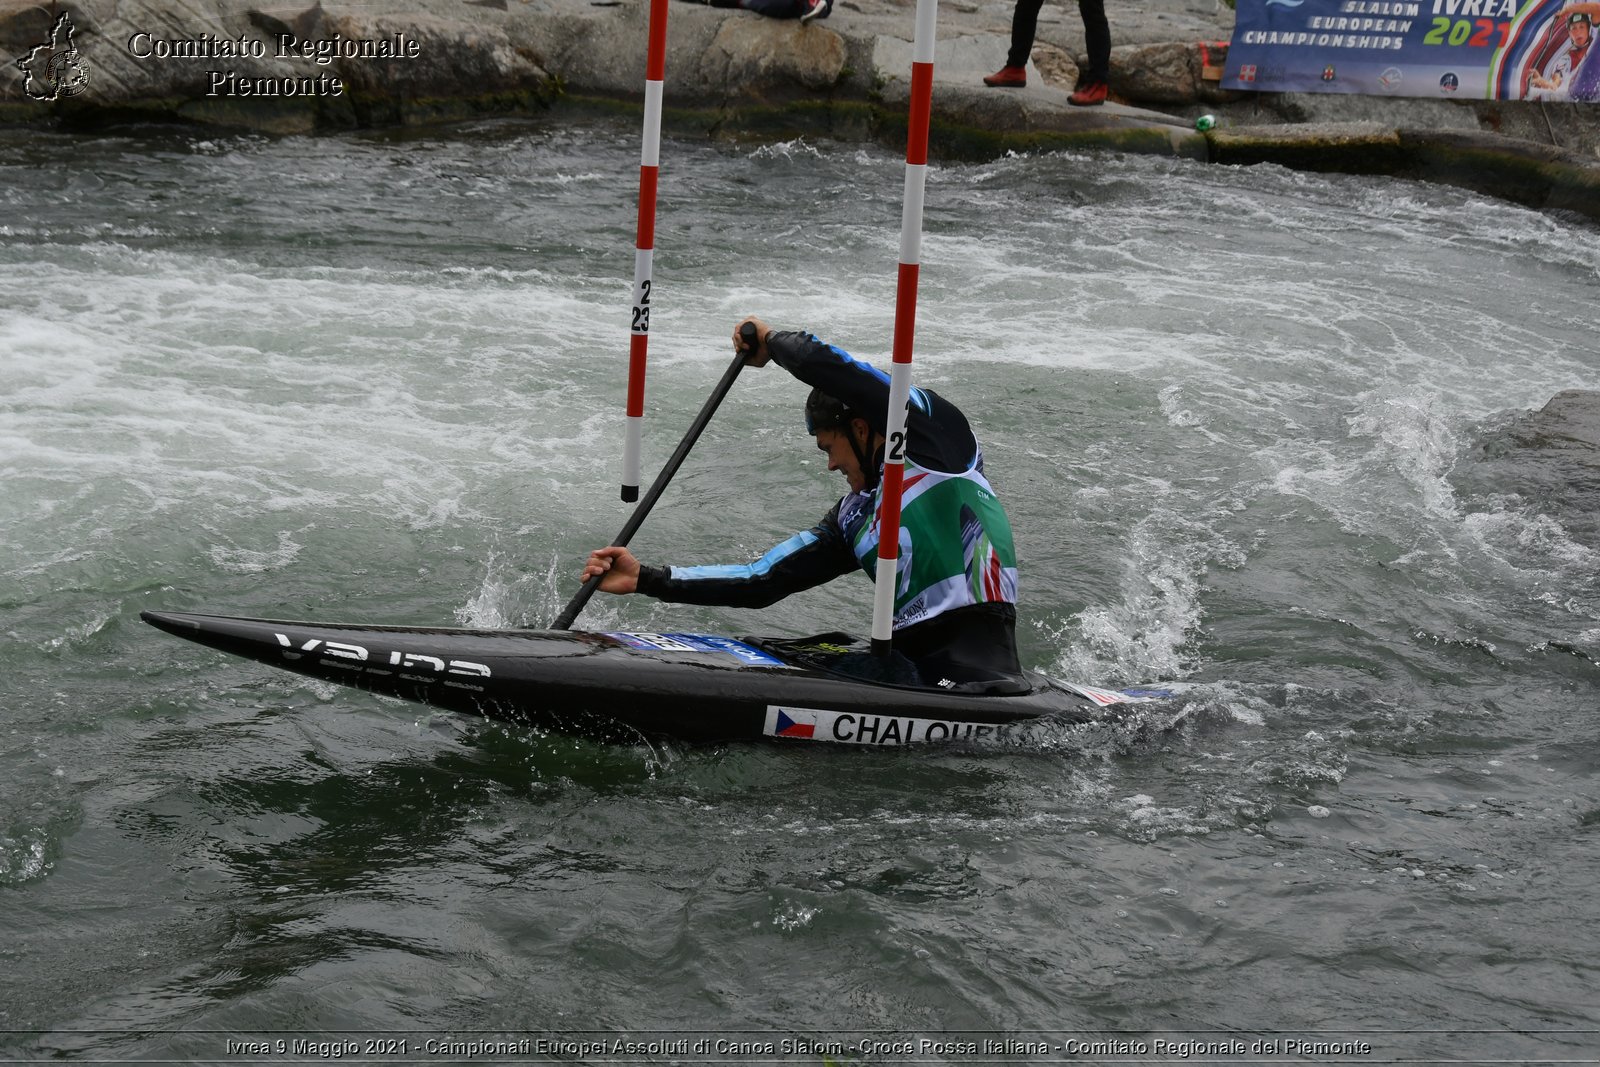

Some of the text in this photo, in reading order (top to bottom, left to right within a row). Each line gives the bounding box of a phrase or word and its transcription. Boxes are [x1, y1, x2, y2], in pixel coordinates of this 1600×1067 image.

[1347, 2, 1419, 17] SLALOM
[1432, 0, 1517, 18] IVREA
[1312, 16, 1412, 33] EUROPEAN
[1423, 17, 1510, 48] 2021
[1245, 31, 1403, 50] CHAMPIONSHIPS
[641, 279, 651, 305] 2
[631, 306, 650, 331] 23
[889, 431, 907, 460] 2
